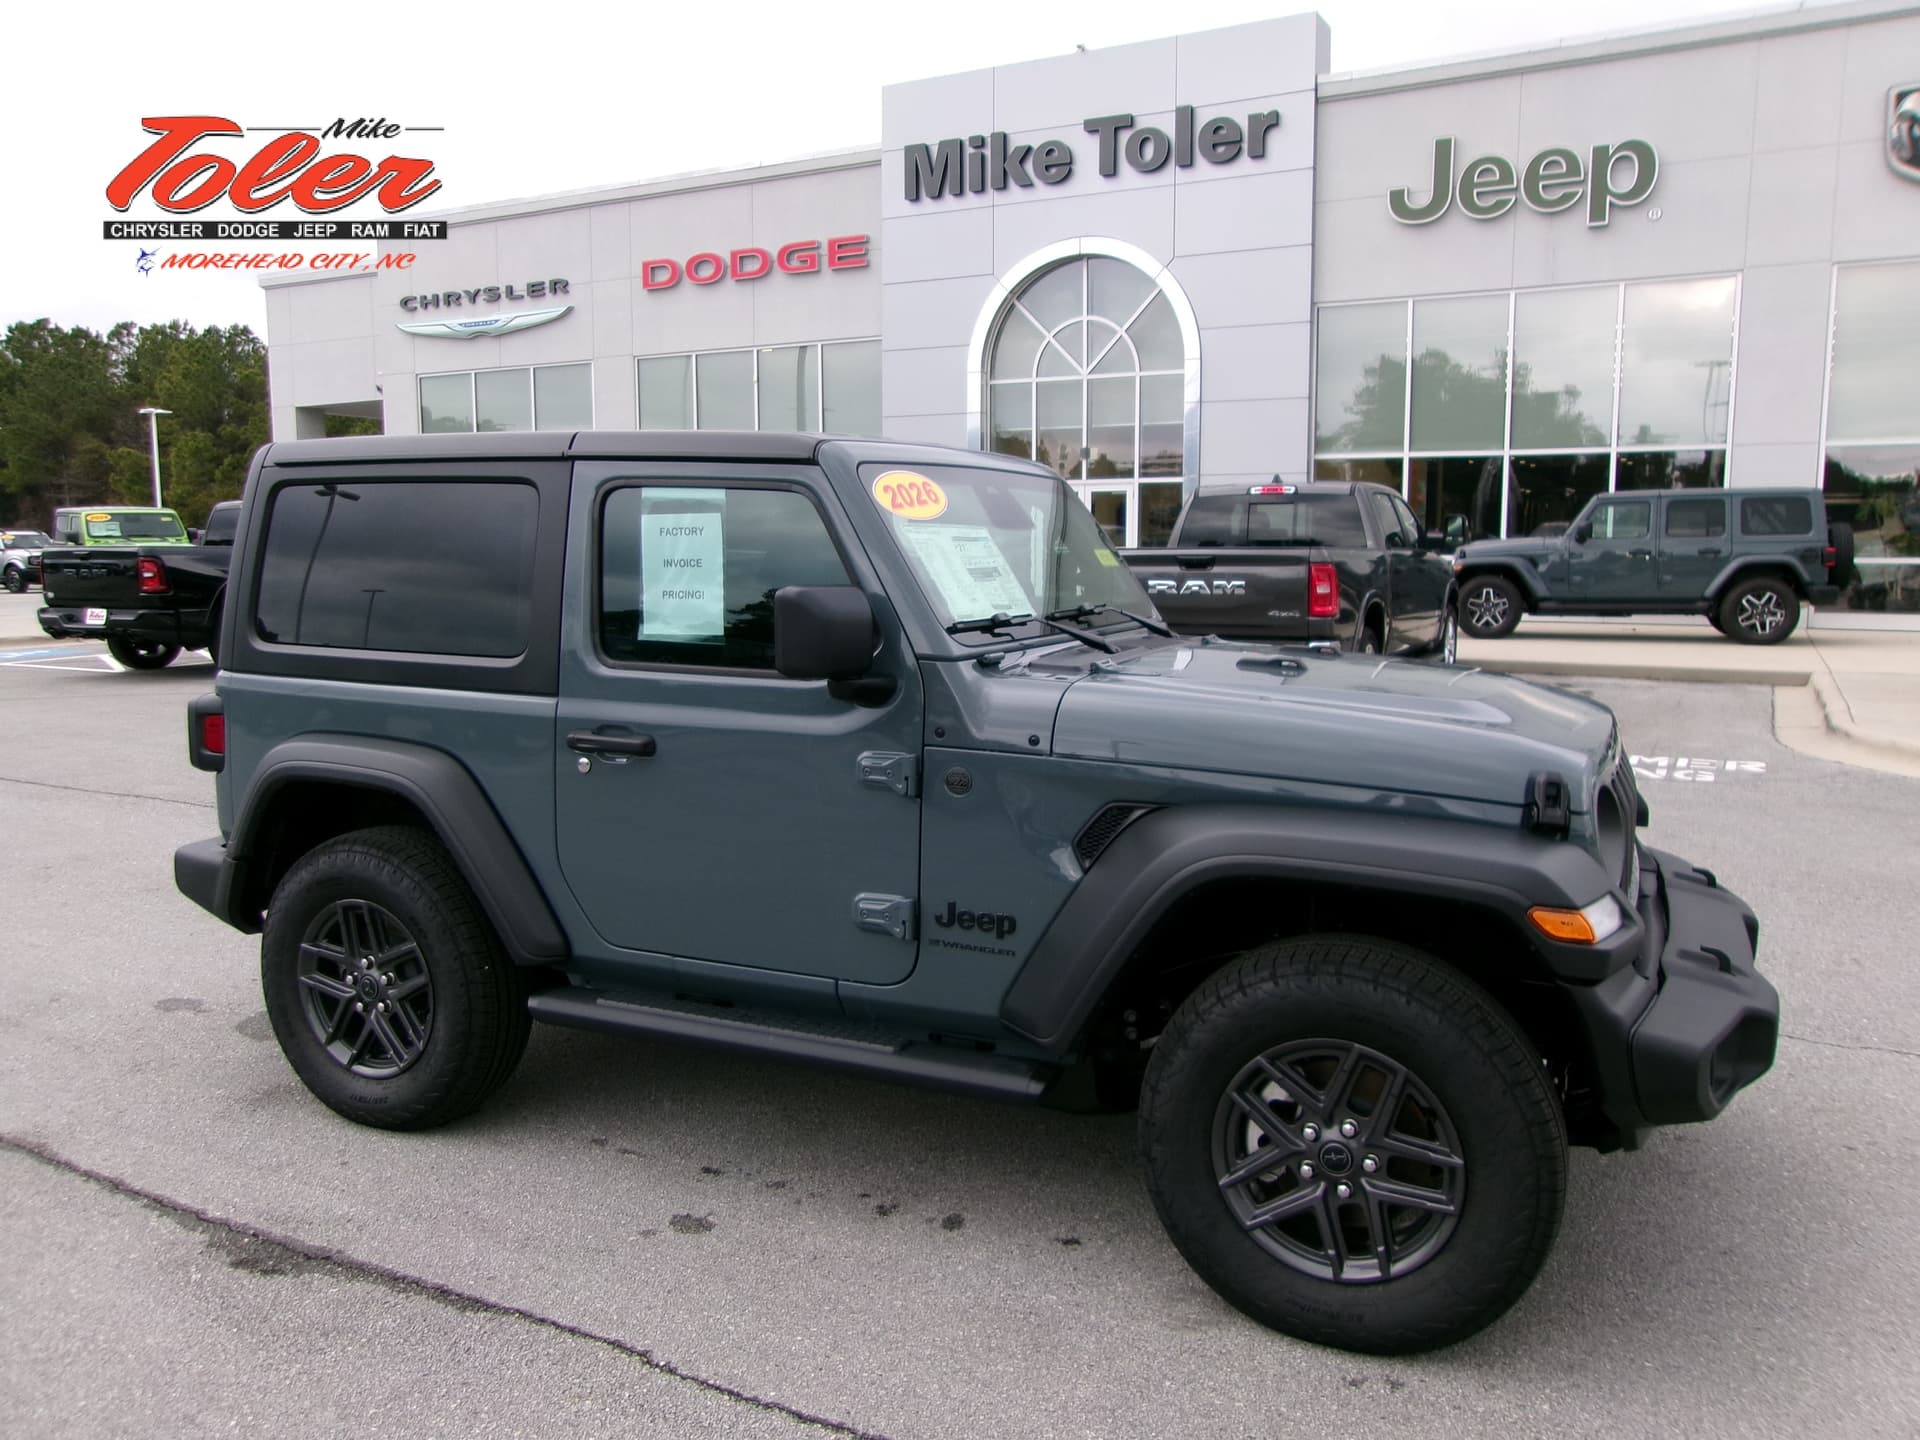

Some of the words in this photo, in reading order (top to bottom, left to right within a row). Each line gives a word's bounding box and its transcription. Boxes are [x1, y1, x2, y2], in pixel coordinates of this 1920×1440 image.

[904, 132, 1073, 202] Mike
[1083, 105, 1280, 177] Toler
[1387, 135, 1660, 228] Jeep
[641, 234, 869, 291] DODGE
[400, 278, 570, 312] CHRYSLER
[882, 481, 941, 510] 2026
[659, 526, 705, 537] FACTORY
[663, 558, 703, 568] INVOICE
[662, 590, 705, 600] PRICING!
[1147, 580, 1246, 595] RAM
[934, 901, 1017, 940] Jeep
[941, 939, 1017, 957] WRANGLER
